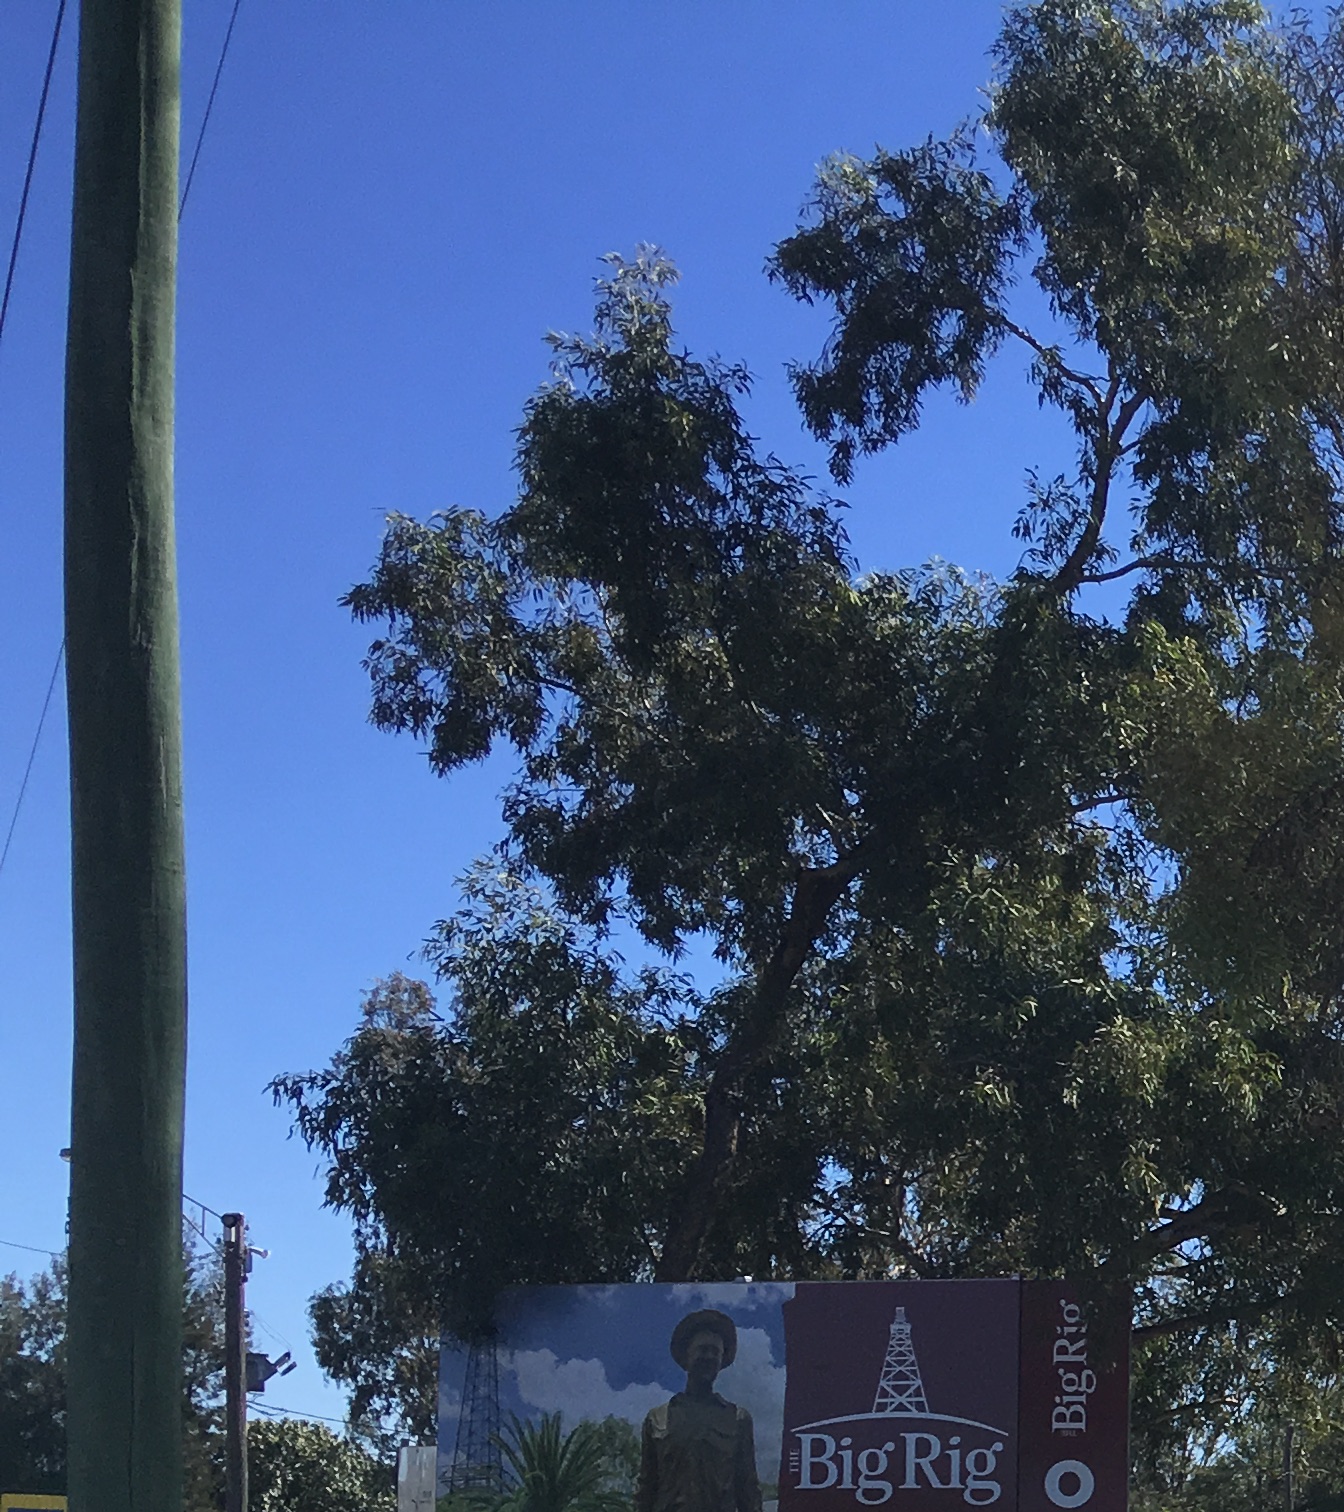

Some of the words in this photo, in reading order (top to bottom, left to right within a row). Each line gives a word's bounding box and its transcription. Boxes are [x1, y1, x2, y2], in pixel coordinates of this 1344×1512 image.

[1051, 1368, 1097, 1433] Big
[794, 1433, 896, 1506] Big
[898, 1432, 1004, 1506] Rig
